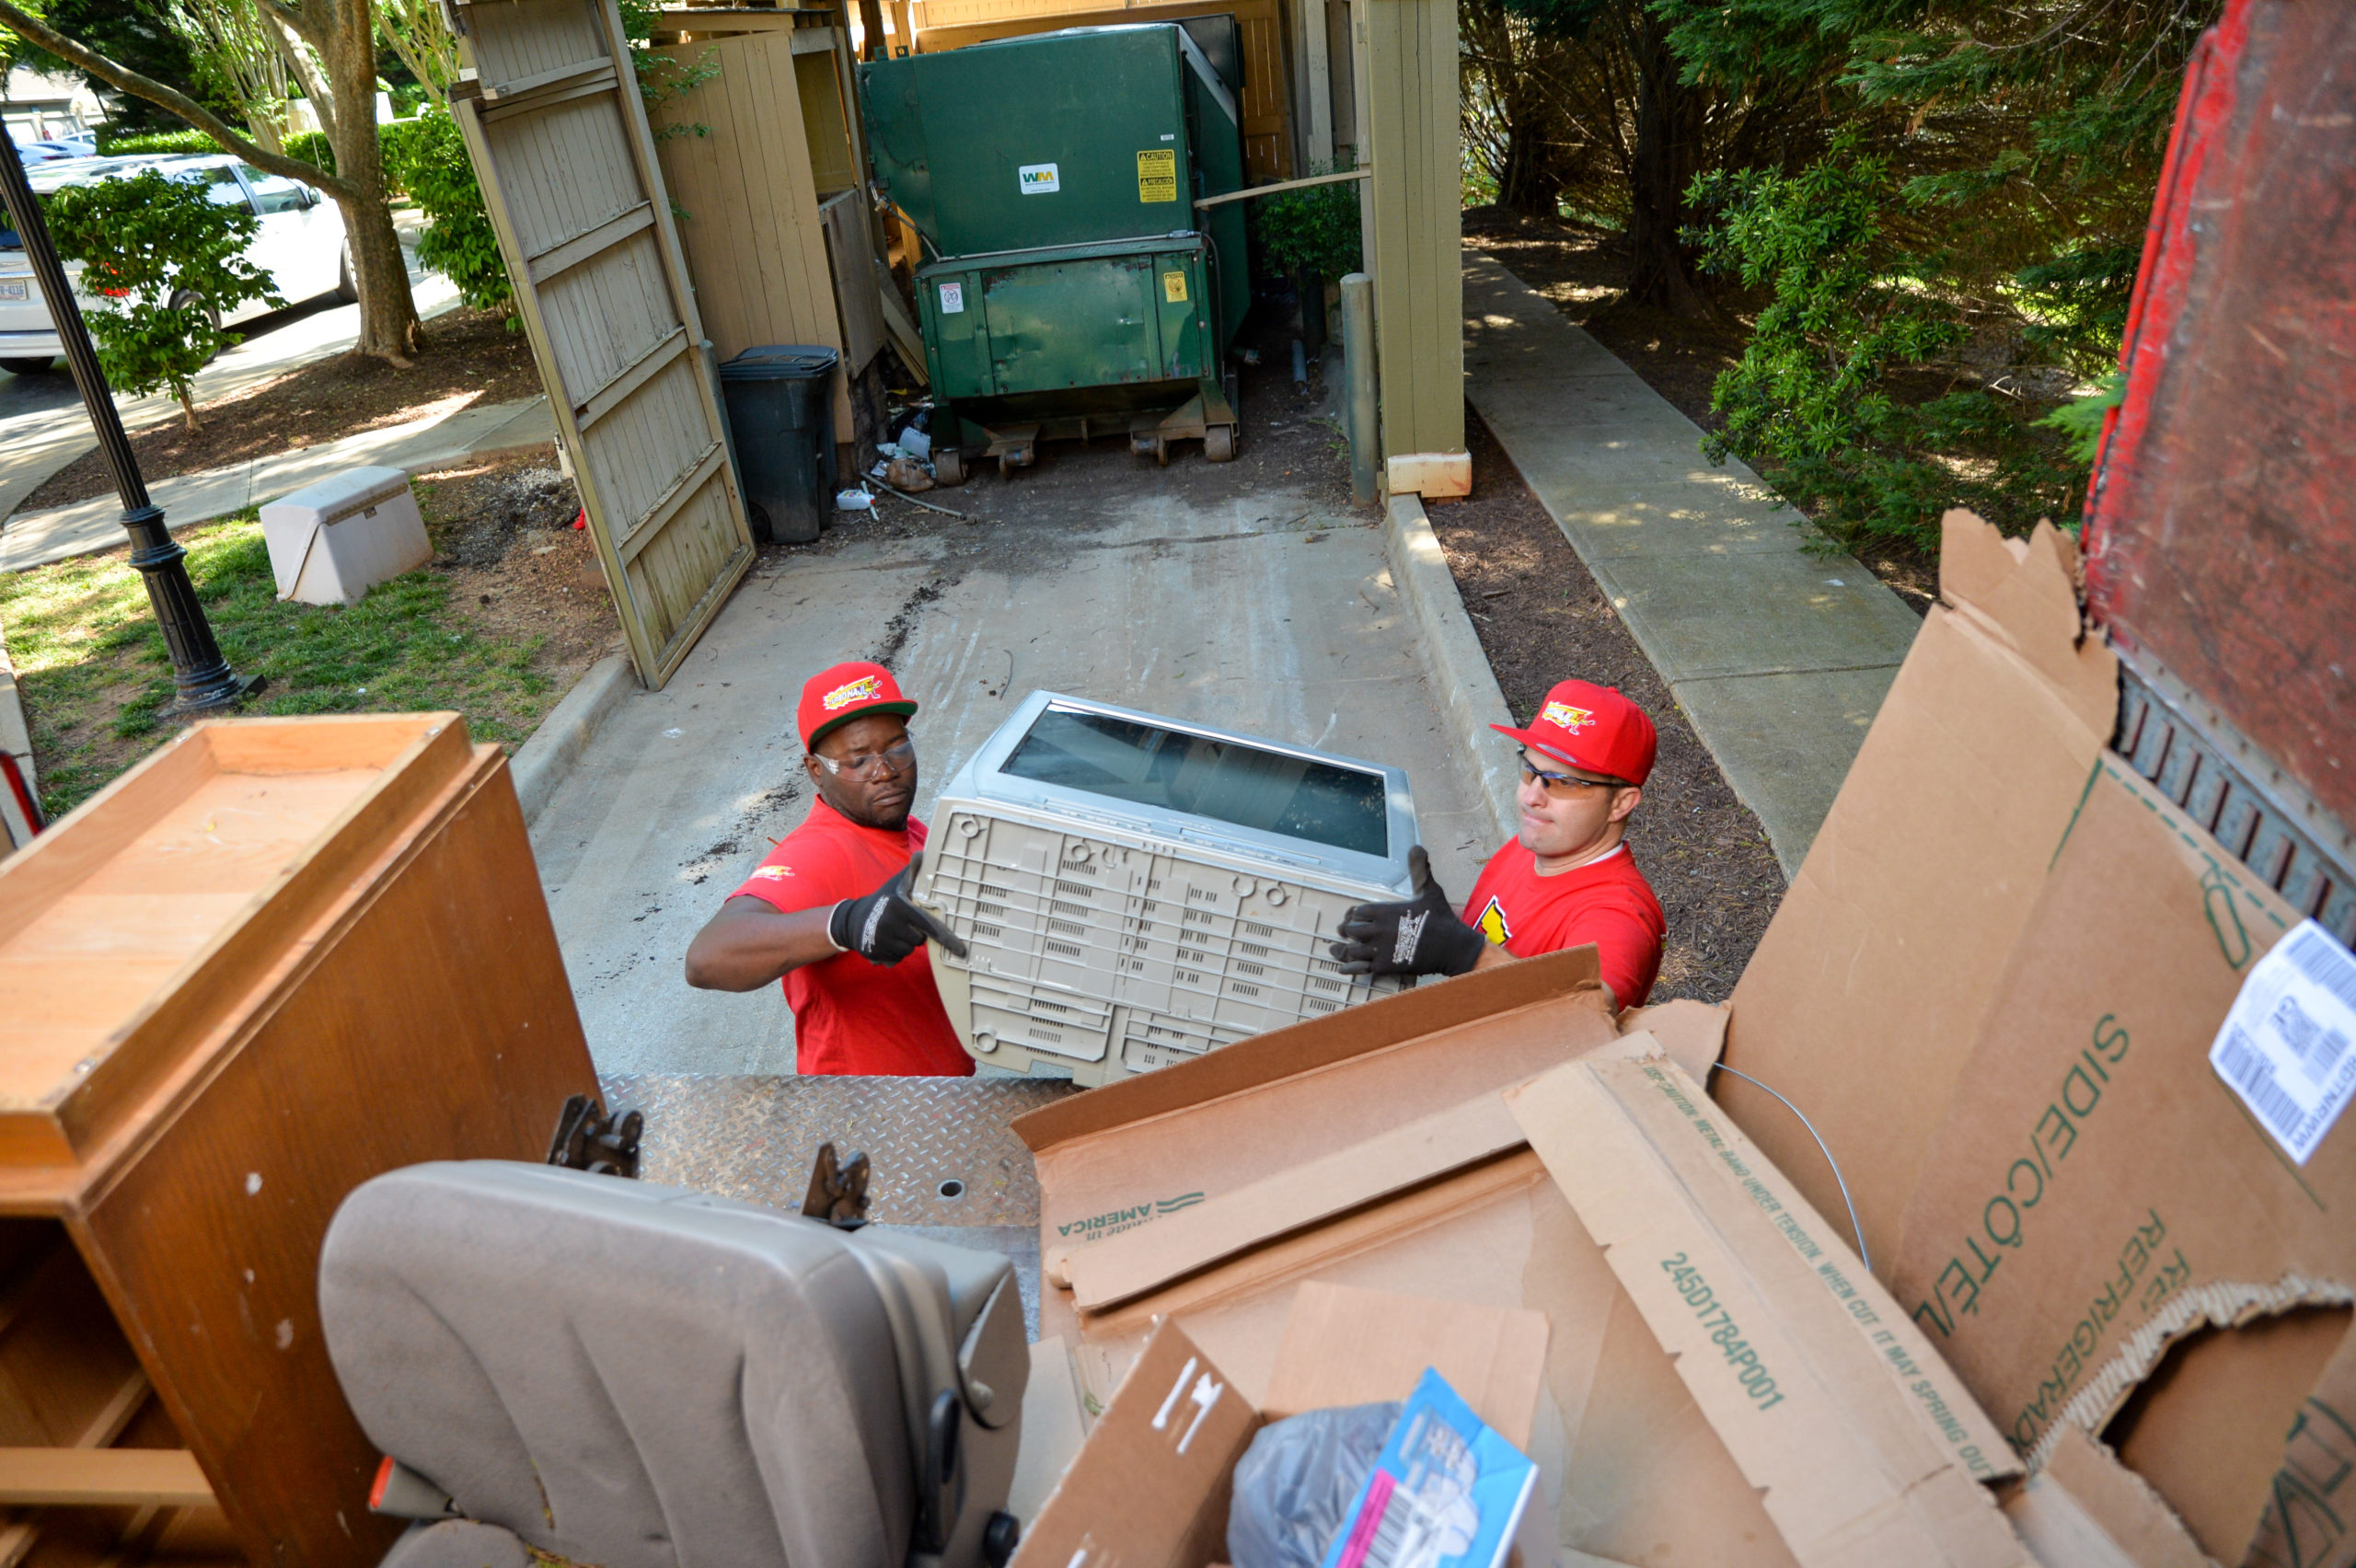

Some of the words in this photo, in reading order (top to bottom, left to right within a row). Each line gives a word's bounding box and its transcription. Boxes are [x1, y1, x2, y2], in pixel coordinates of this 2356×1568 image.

[1147, 151, 1172, 160] CAUTION
[1022, 171, 1054, 183] WM
[1057, 1203, 1152, 1237] AMERICA
[1693, 1119, 1726, 1148] METAL
[1718, 1150, 1751, 1177] BAND
[1742, 1177, 1783, 1213] UNDER
[1817, 1262, 1857, 1301] WHEN
[1846, 1298, 1880, 1326] CUT
[1872, 1330, 1896, 1346] IT
[1886, 1344, 1922, 1378] MAY
[1911, 1379, 1969, 1444] SPRING
[1660, 1252, 1785, 1412] 245D1784P001
